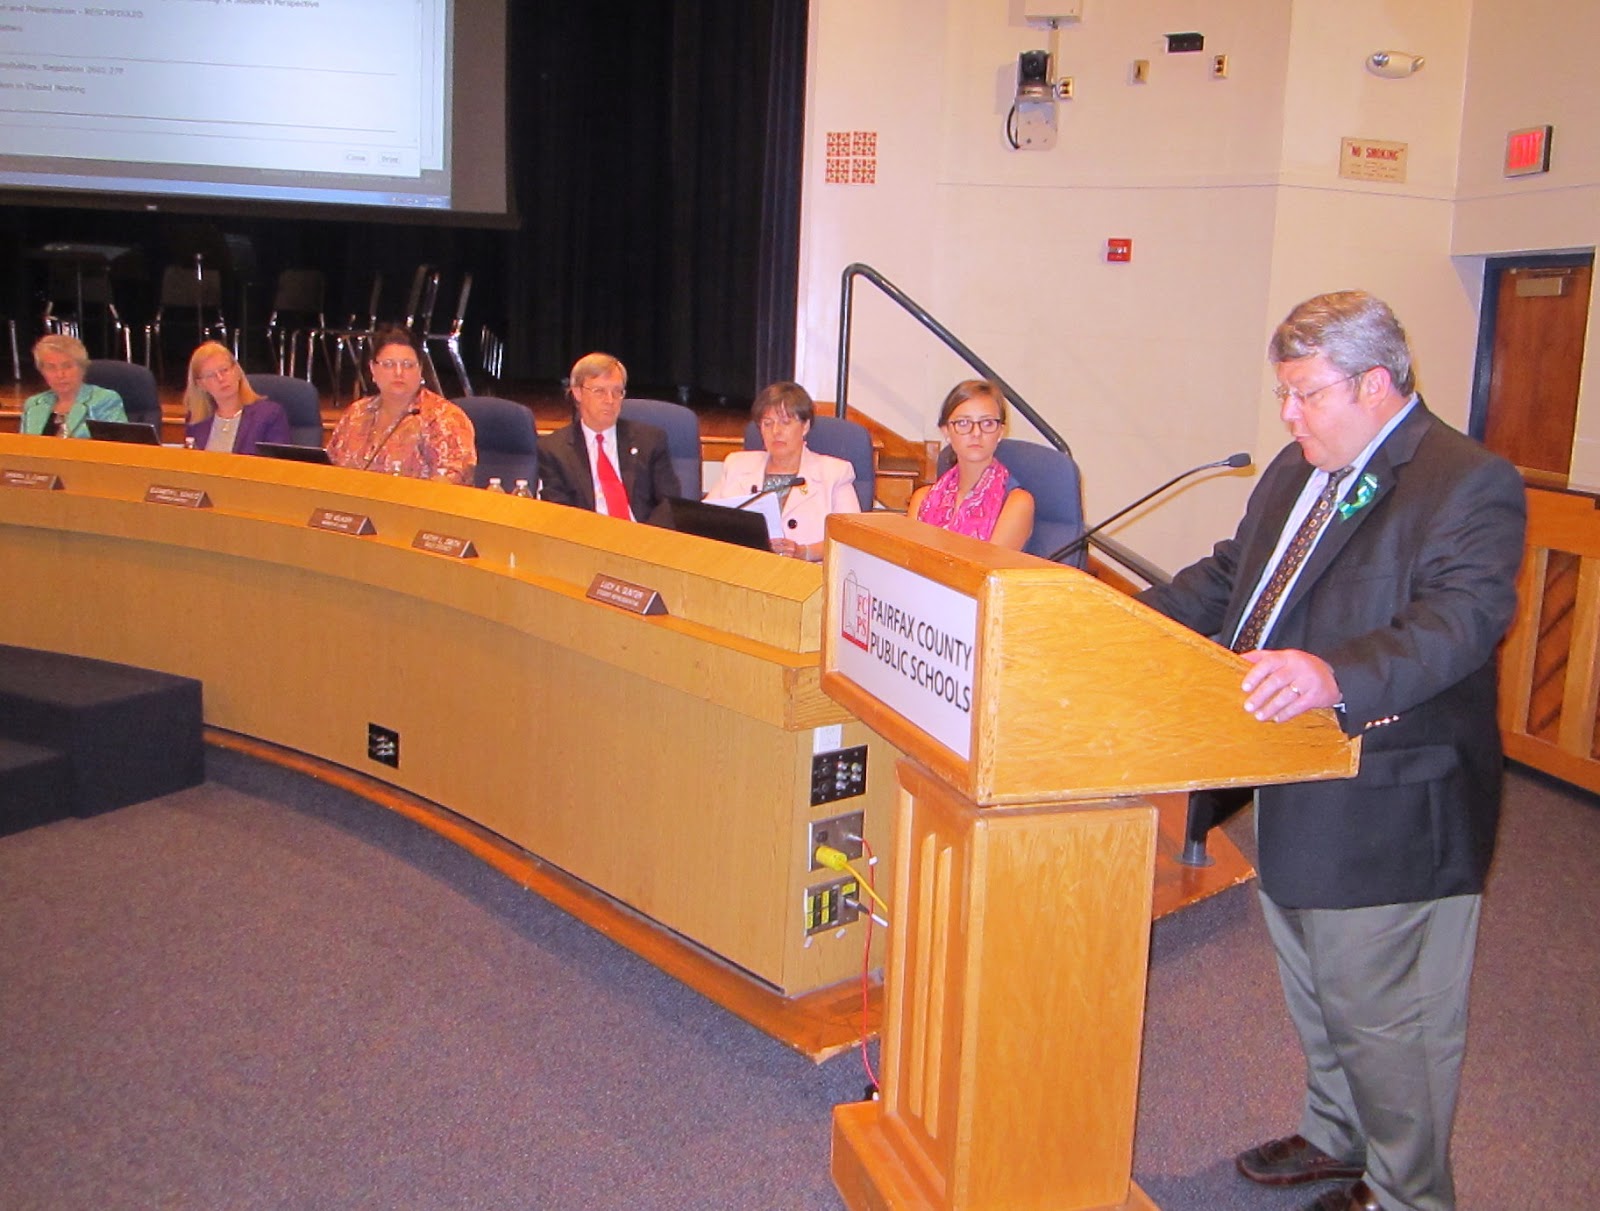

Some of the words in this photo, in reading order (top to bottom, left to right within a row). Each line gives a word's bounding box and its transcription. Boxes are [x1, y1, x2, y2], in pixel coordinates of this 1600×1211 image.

[1365, 146, 1399, 161] SMOKING
[857, 595, 868, 615] FC
[856, 616, 867, 636] PS
[870, 597, 915, 642] FAIRFAX
[916, 621, 972, 671] COUNTY
[869, 632, 908, 677] PUBLIC
[910, 655, 971, 713] SCHOOLS
